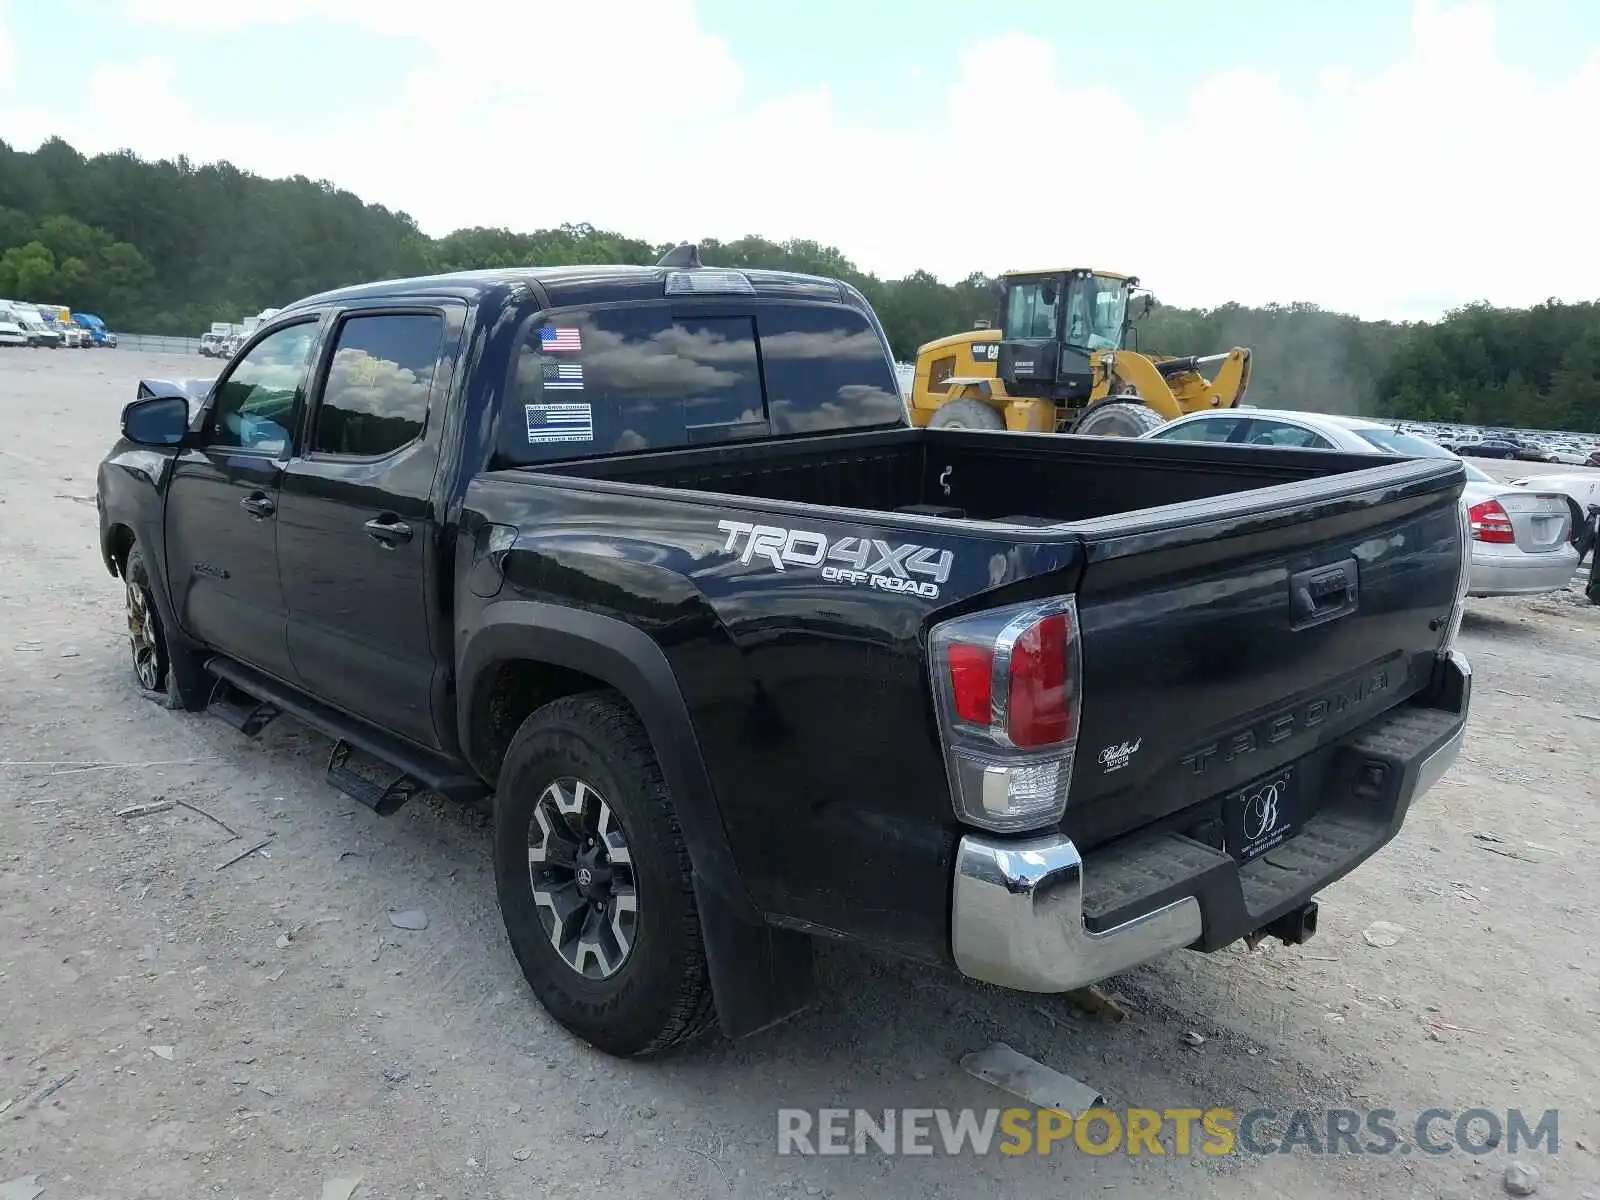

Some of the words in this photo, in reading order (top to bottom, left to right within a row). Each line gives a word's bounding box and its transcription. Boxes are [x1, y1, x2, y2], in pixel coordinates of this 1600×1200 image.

[718, 520, 828, 573] TRD
[822, 566, 869, 586] OFF
[869, 573, 940, 600] ROAD
[1179, 672, 1388, 775] TACOMA
[1107, 755, 1129, 767] TOYOTA
